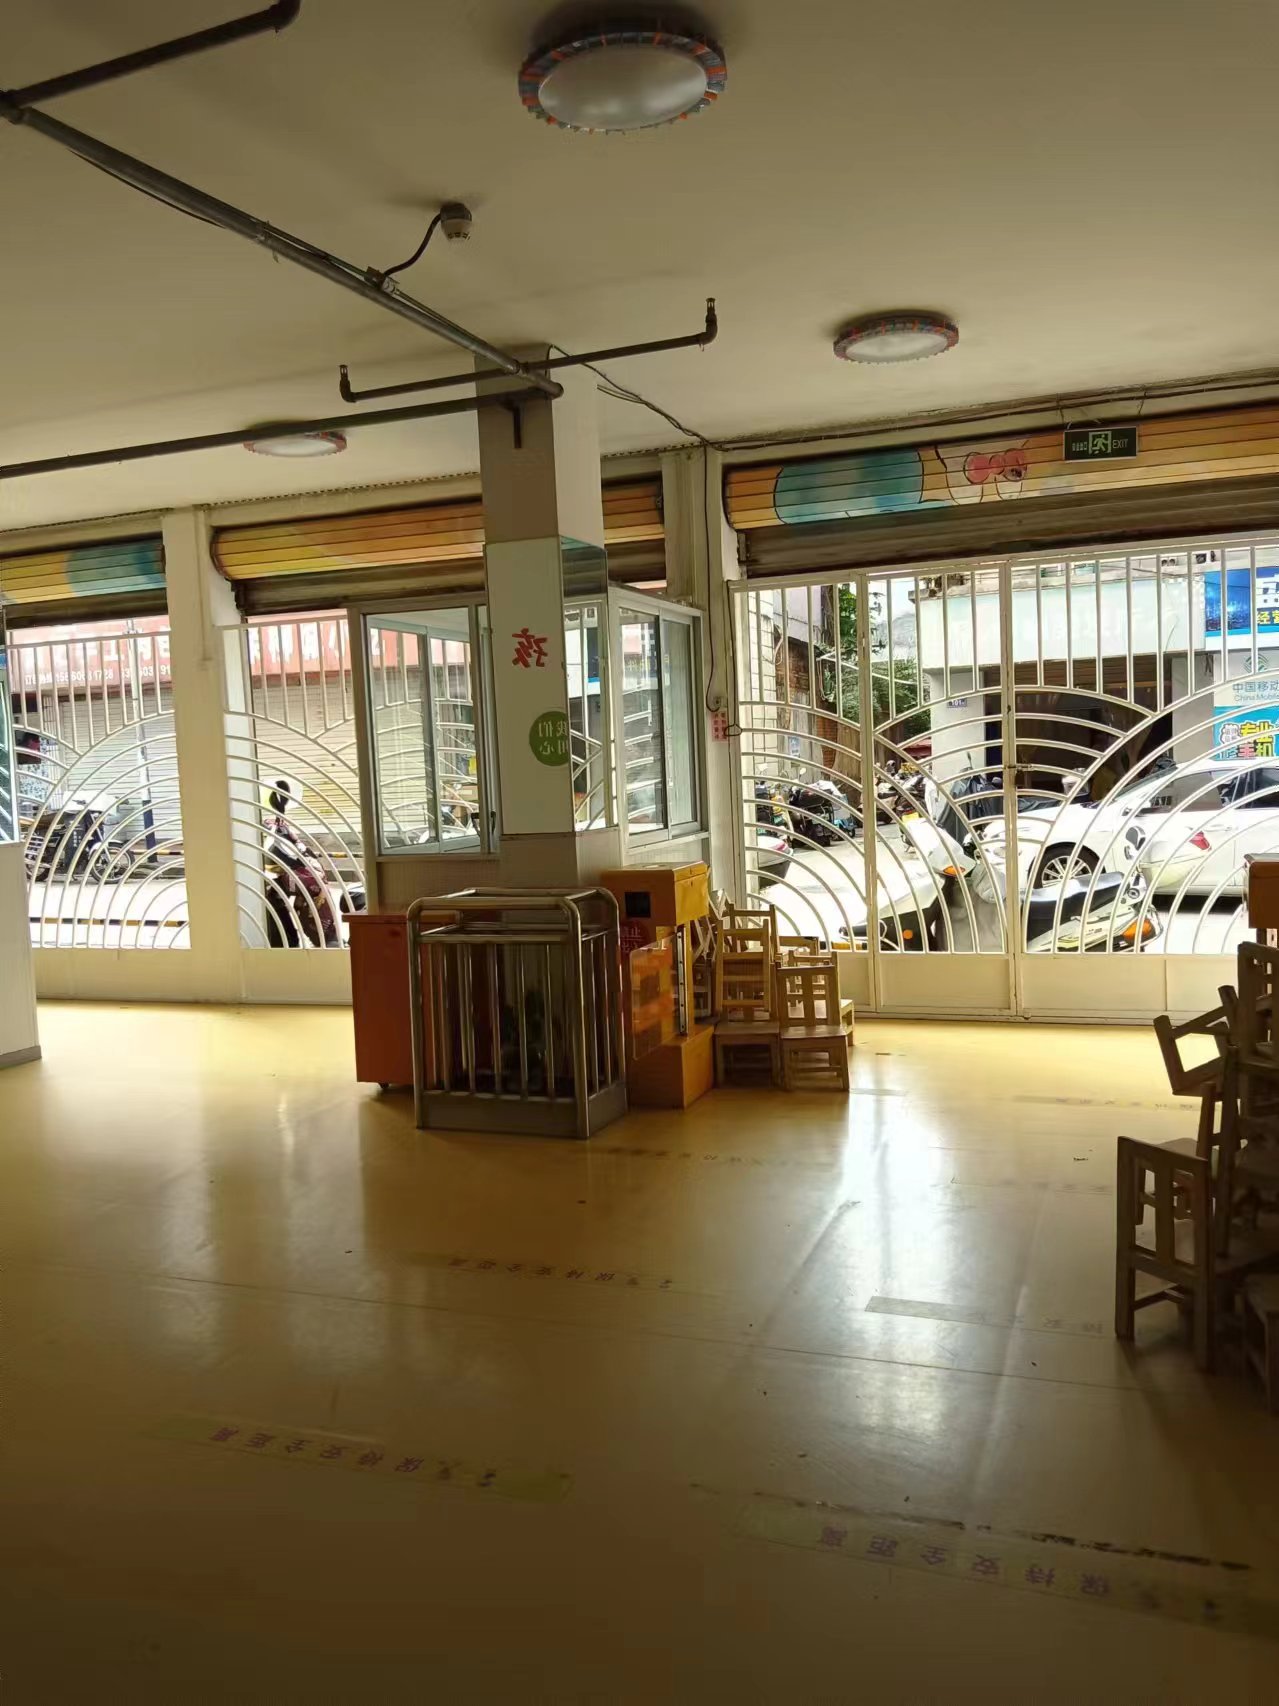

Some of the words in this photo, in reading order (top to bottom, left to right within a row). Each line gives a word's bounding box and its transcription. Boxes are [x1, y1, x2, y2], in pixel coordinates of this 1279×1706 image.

[1112, 438, 1128, 449] EXIT
[1232, 680, 1279, 693] 中国移动
[815, 1525, 1111, 1598] 保持安全距离
